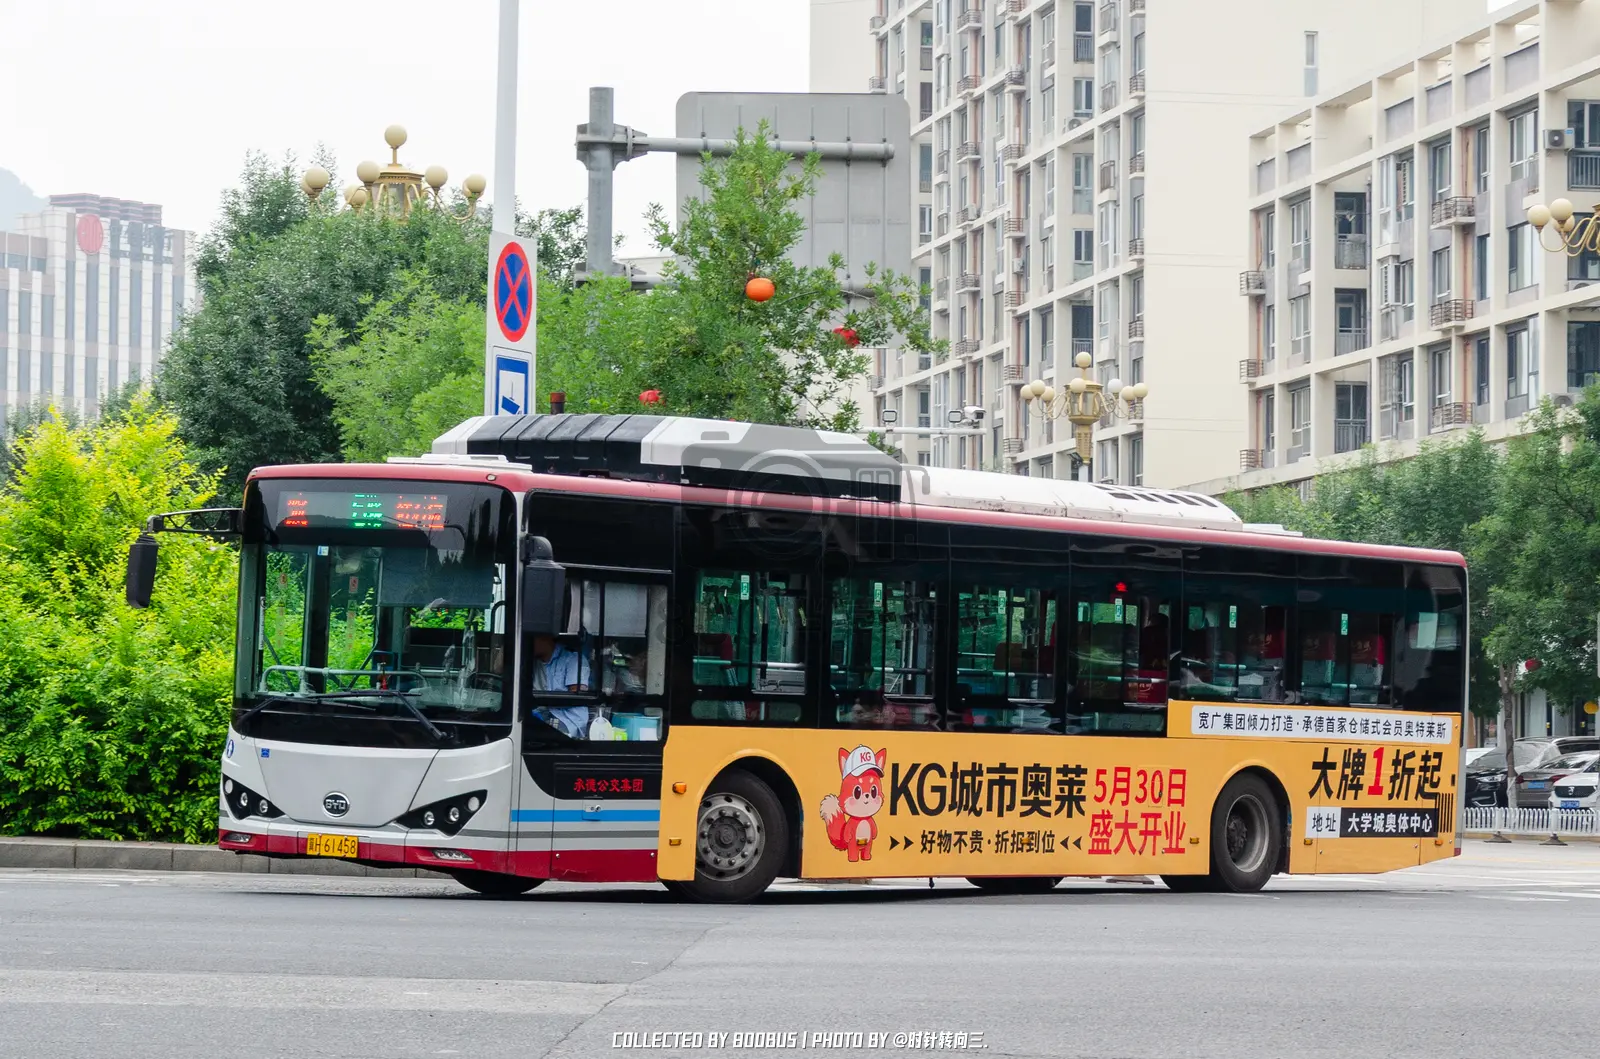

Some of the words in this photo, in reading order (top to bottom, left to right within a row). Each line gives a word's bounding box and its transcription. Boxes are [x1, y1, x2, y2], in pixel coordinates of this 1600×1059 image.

[1199, 712, 1446, 738] 宽广集团倾力打造·承德首家仓储式会员奥特莱斯
[860, 752, 871, 762] KG
[1308, 747, 1443, 800] 大牌1折起
[889, 761, 1088, 818] KG城市奥莱
[1093, 766, 1187, 807] 5月30日
[325, 799, 346, 809] BYD
[1088, 809, 1186, 856] 盛大开业
[1312, 813, 1336, 832] 地址
[1348, 813, 1433, 833] 大学城奥体中心
[920, 829, 1055, 854] 好物不贵·折扣到位
